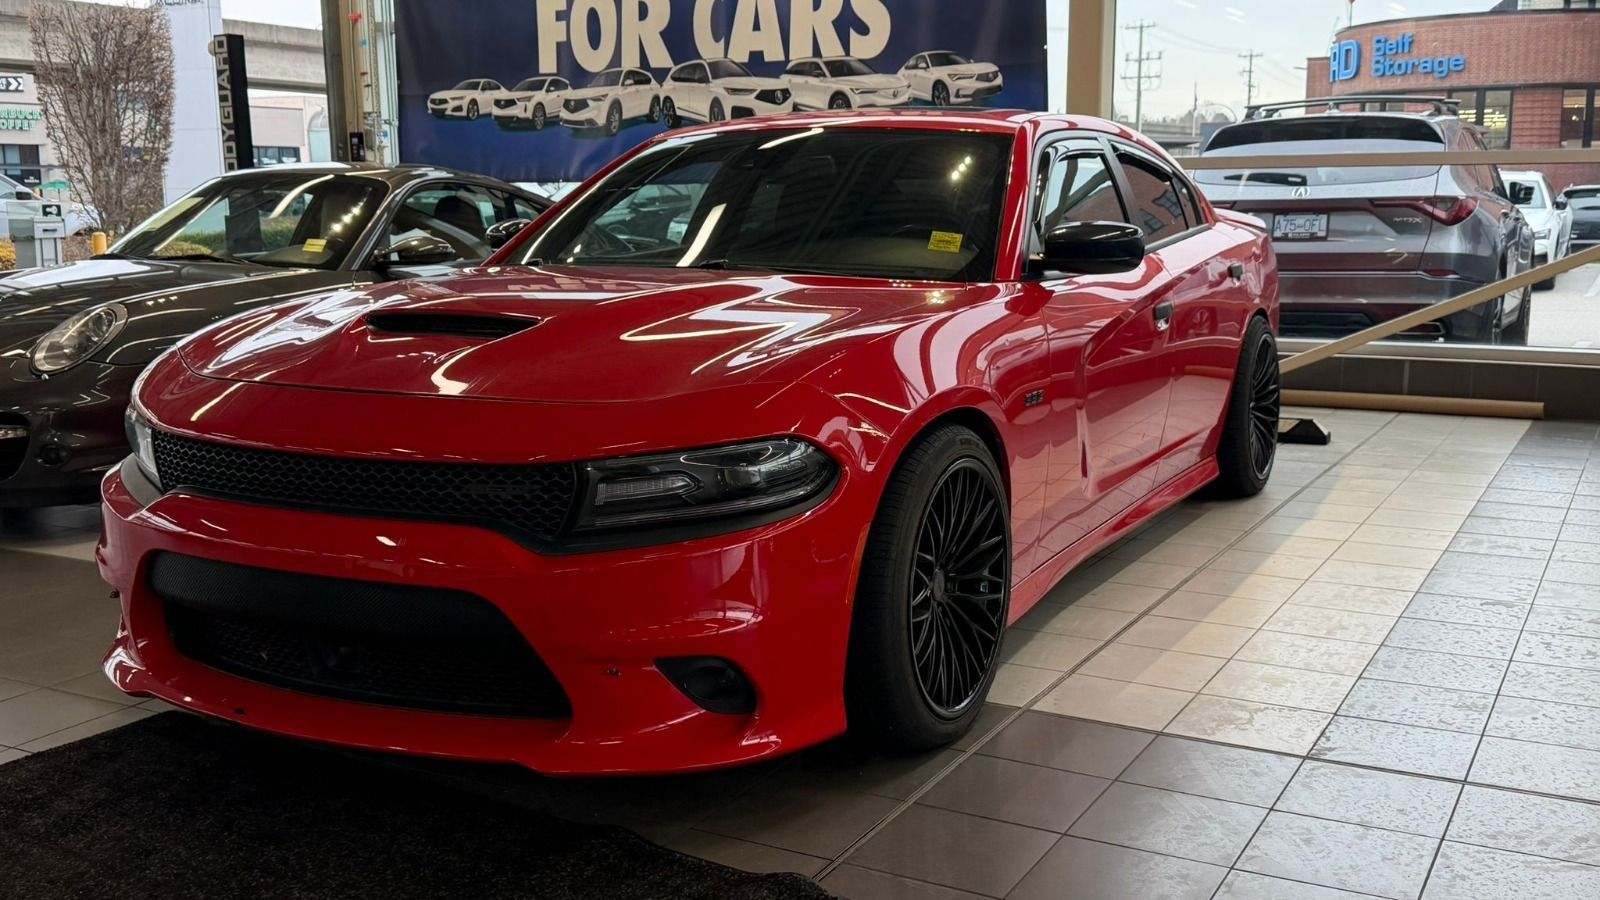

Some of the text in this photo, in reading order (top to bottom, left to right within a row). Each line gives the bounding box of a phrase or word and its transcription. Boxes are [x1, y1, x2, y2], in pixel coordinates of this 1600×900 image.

[537, 0, 892, 74] FOR CARS
[1372, 32, 1414, 56] Self
[1371, 55, 1466, 79] Storage
